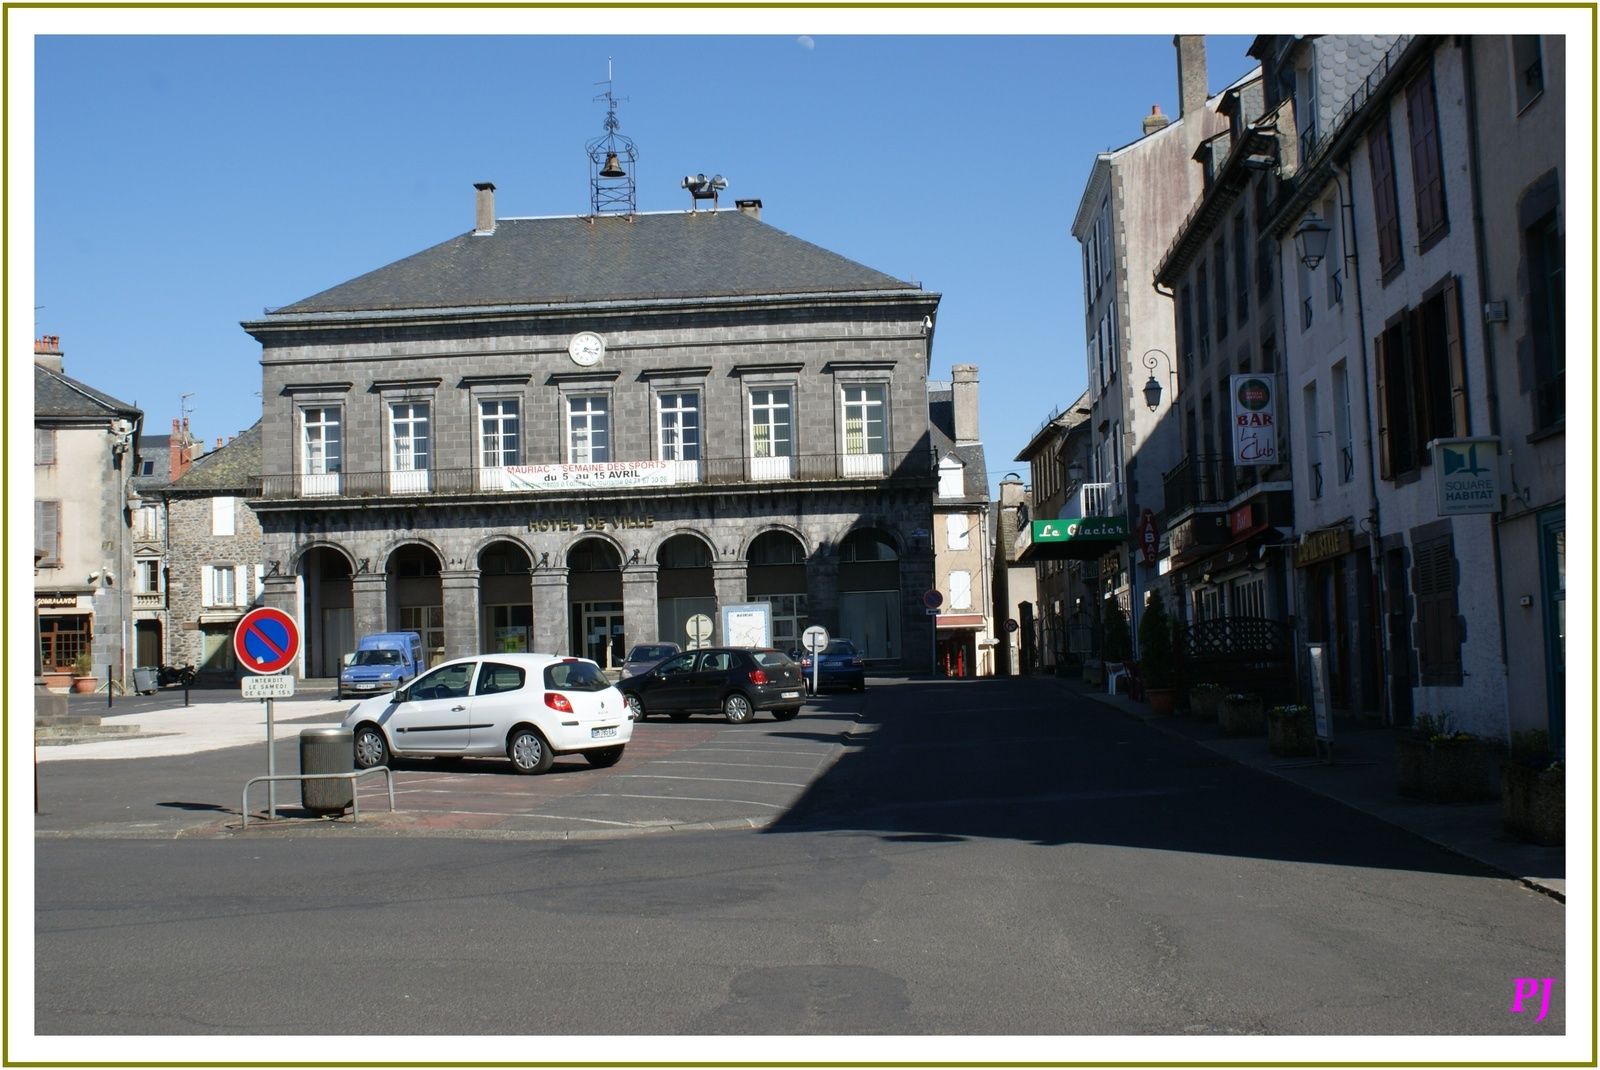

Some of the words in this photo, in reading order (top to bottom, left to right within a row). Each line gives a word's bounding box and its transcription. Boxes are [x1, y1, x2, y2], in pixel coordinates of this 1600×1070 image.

[1237, 414, 1273, 426] BAR
[1240, 428, 1257, 442] Le
[1240, 438, 1274, 460] Club
[507, 466, 550, 474] MAURIAC
[607, 463, 625, 471] DES
[608, 470, 640, 478] AVRIL
[1446, 480, 1494, 490] SQUARE
[1446, 490, 1494, 500] HABITAT
[528, 517, 578, 532] HOTEL
[584, 516, 606, 530] DE
[613, 515, 656, 529] VILLE
[1039, 524, 1060, 537] Le
[1067, 524, 1124, 537] Glacier
[1144, 513, 1156, 561] TABAC
